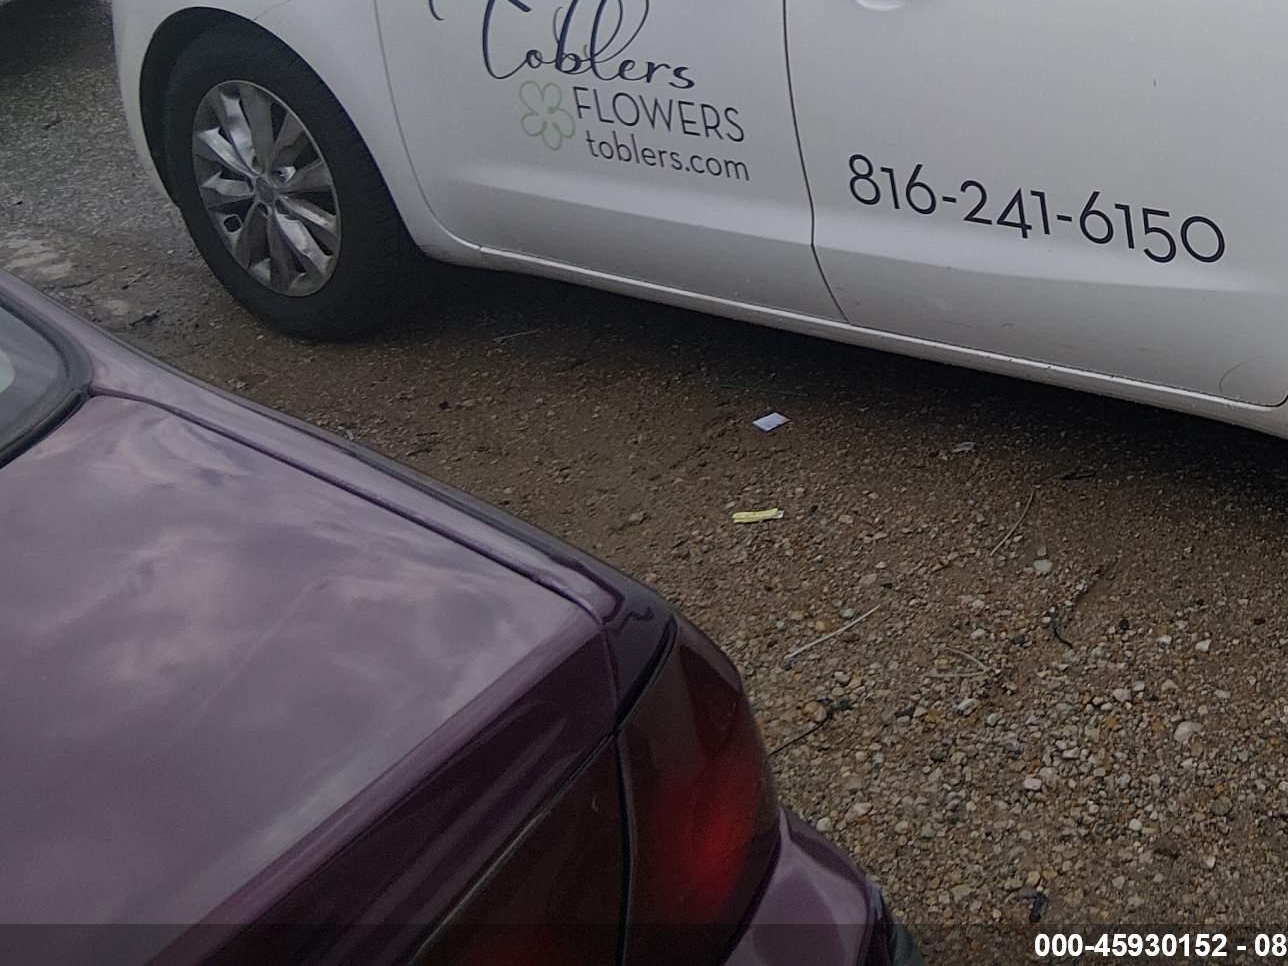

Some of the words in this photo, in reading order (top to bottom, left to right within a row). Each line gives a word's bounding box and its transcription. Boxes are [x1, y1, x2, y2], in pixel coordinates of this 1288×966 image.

[571, 85, 746, 143] FLOWERS
[586, 130, 751, 181] toblers.com
[848, 153, 1226, 263] 816-241-6150
